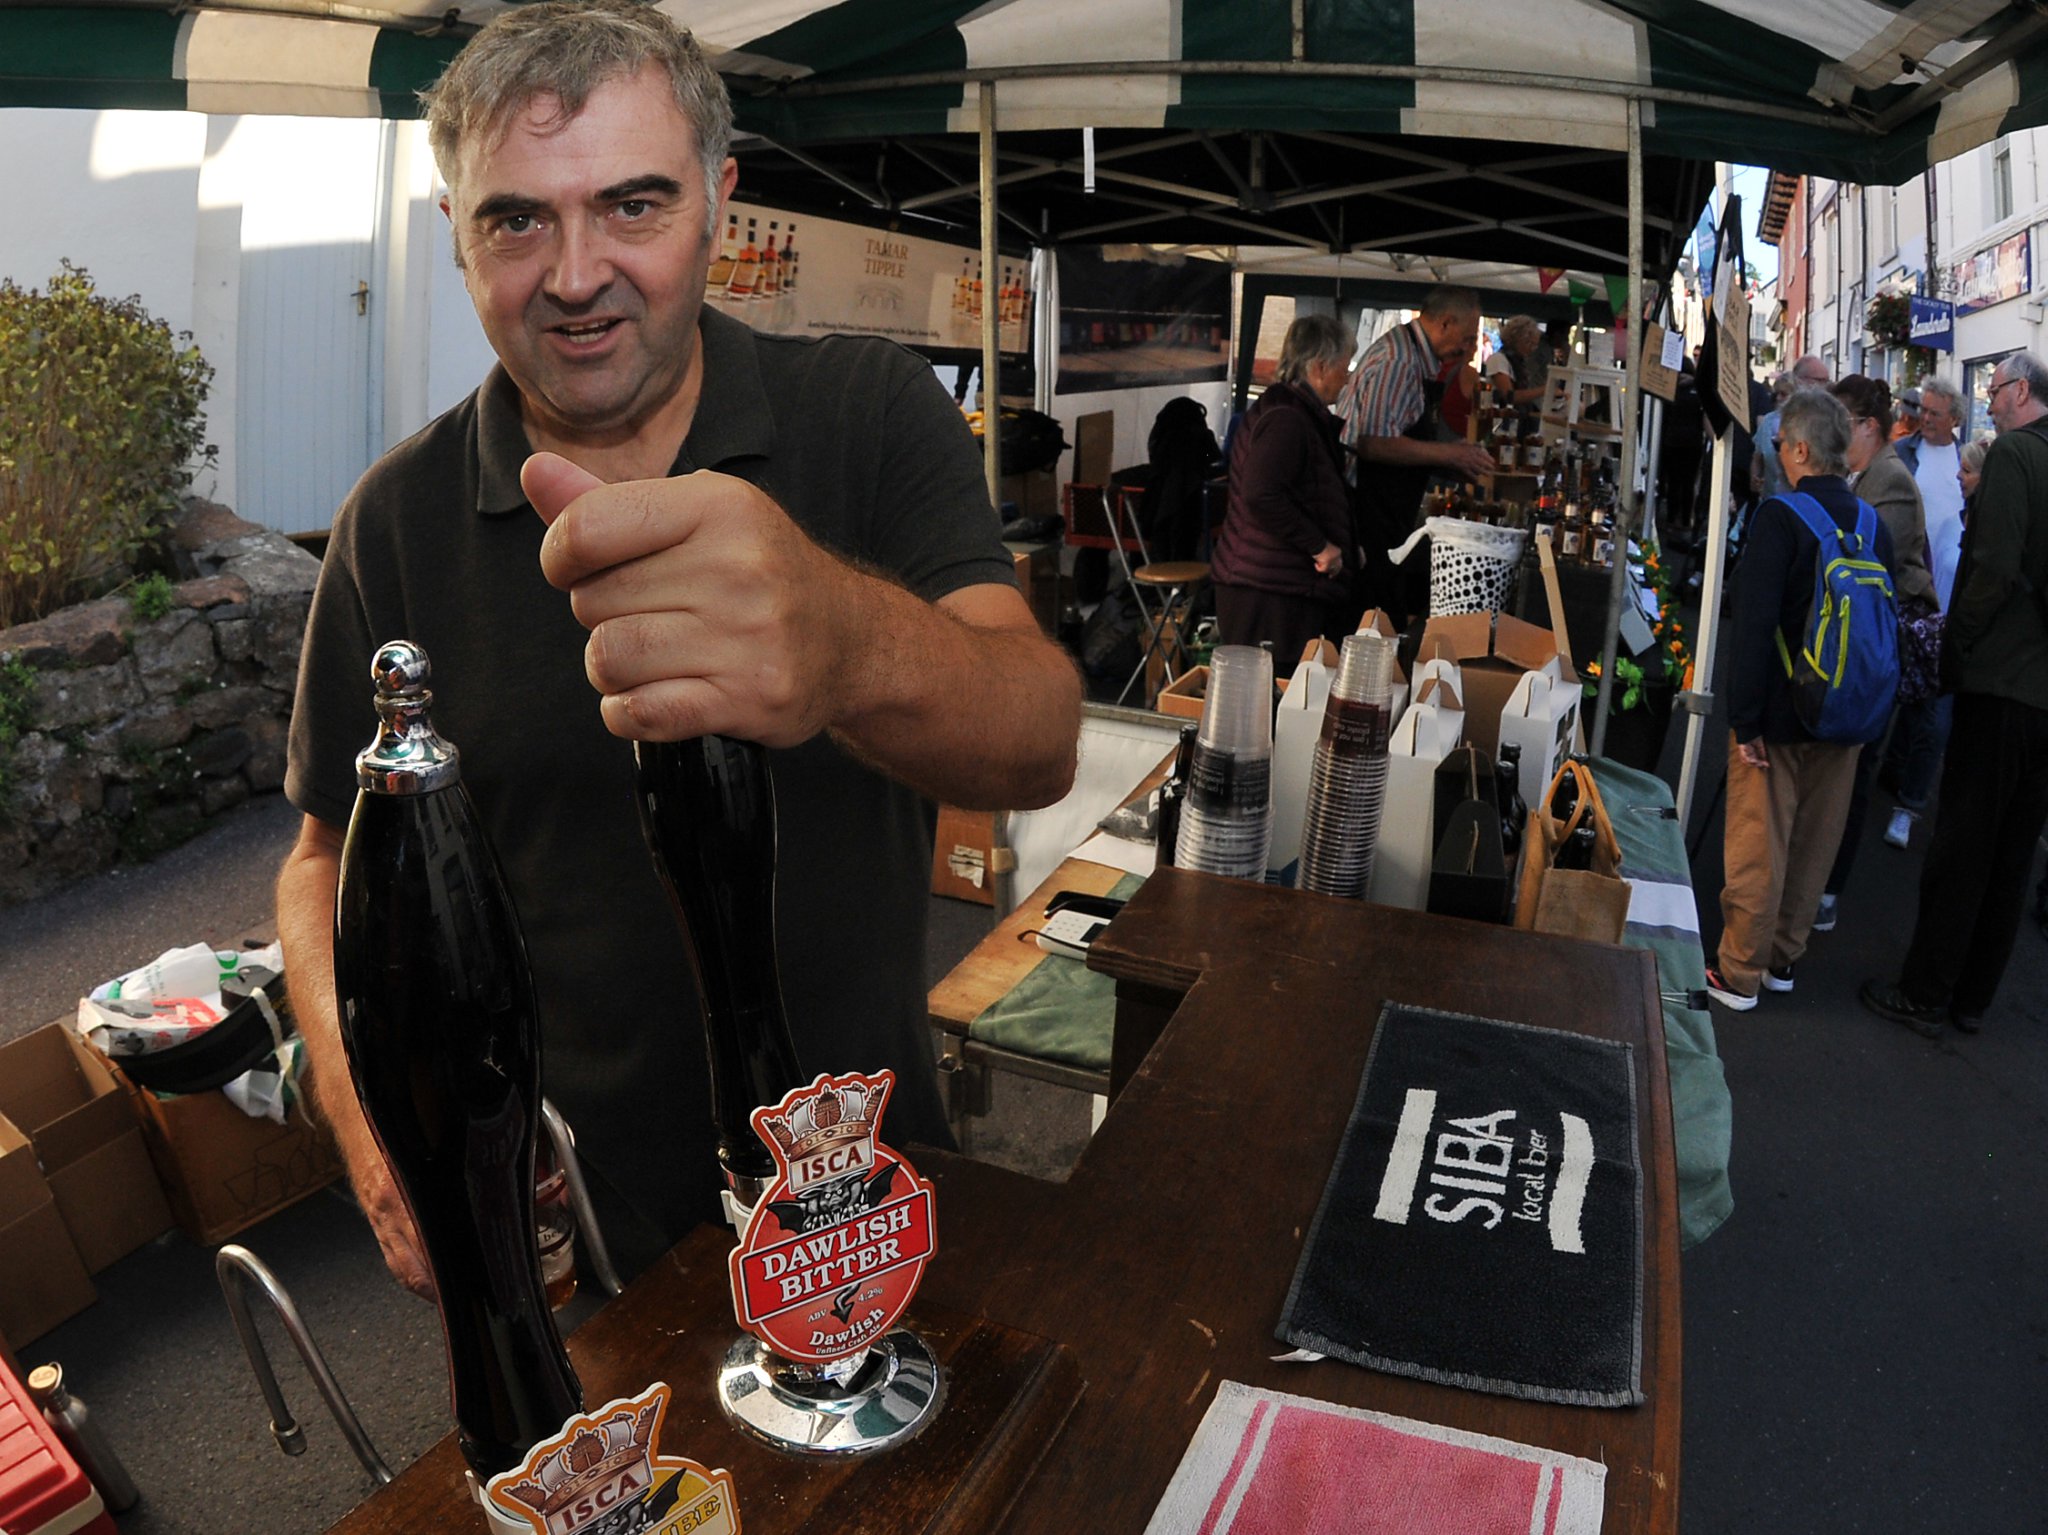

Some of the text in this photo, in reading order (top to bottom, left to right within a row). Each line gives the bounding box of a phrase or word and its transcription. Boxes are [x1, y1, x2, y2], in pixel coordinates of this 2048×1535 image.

[863, 258, 905, 279] TIPPLE
[864, 238, 909, 260] TAMAR
[801, 1145, 863, 1183] ISCA
[1423, 1109, 1517, 1231] SIBA
[1511, 1172, 1546, 1223] local
[763, 1204, 912, 1281] DAWLISH
[779, 1237, 902, 1303] BITTER
[807, 1287, 884, 1323] ABV 4.2%
[808, 1308, 886, 1347] Dawlish
[815, 1343, 847, 1355] Unfined
[868, 1323, 881, 1336] Ale
[561, 1472, 641, 1531] ISCA
